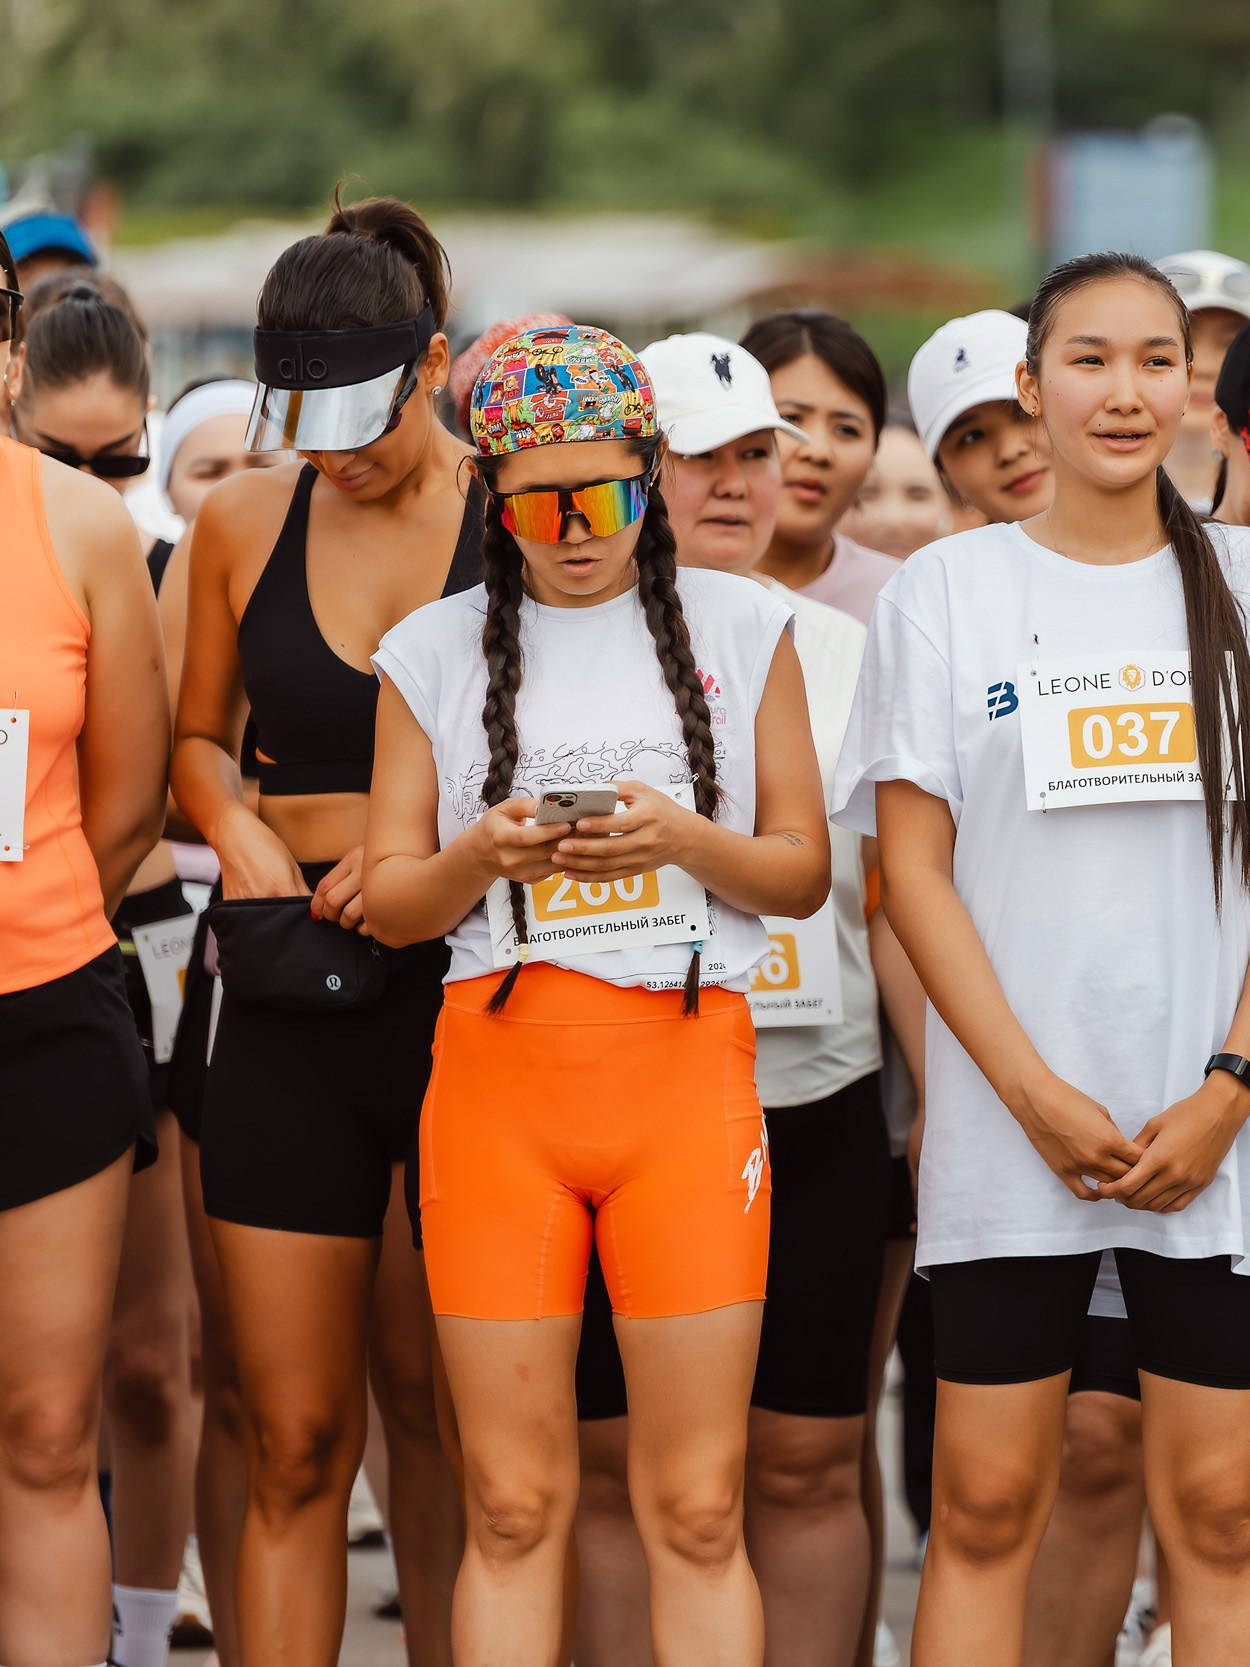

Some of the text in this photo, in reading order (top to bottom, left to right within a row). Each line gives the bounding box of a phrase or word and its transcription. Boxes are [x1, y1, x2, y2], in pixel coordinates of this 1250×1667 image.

[279, 343, 328, 381] alo
[1037, 670, 1193, 696] LEONE D'O
[1082, 711, 1181, 760] 037
[1048, 770, 1185, 791] БЛАГОТВОРИТЕЛЬНЫЙ
[513, 914, 687, 947] БАГОТВОРИТЕЛЬНЫЙ ЗАБЕГ
[152, 936, 193, 960] LEON
